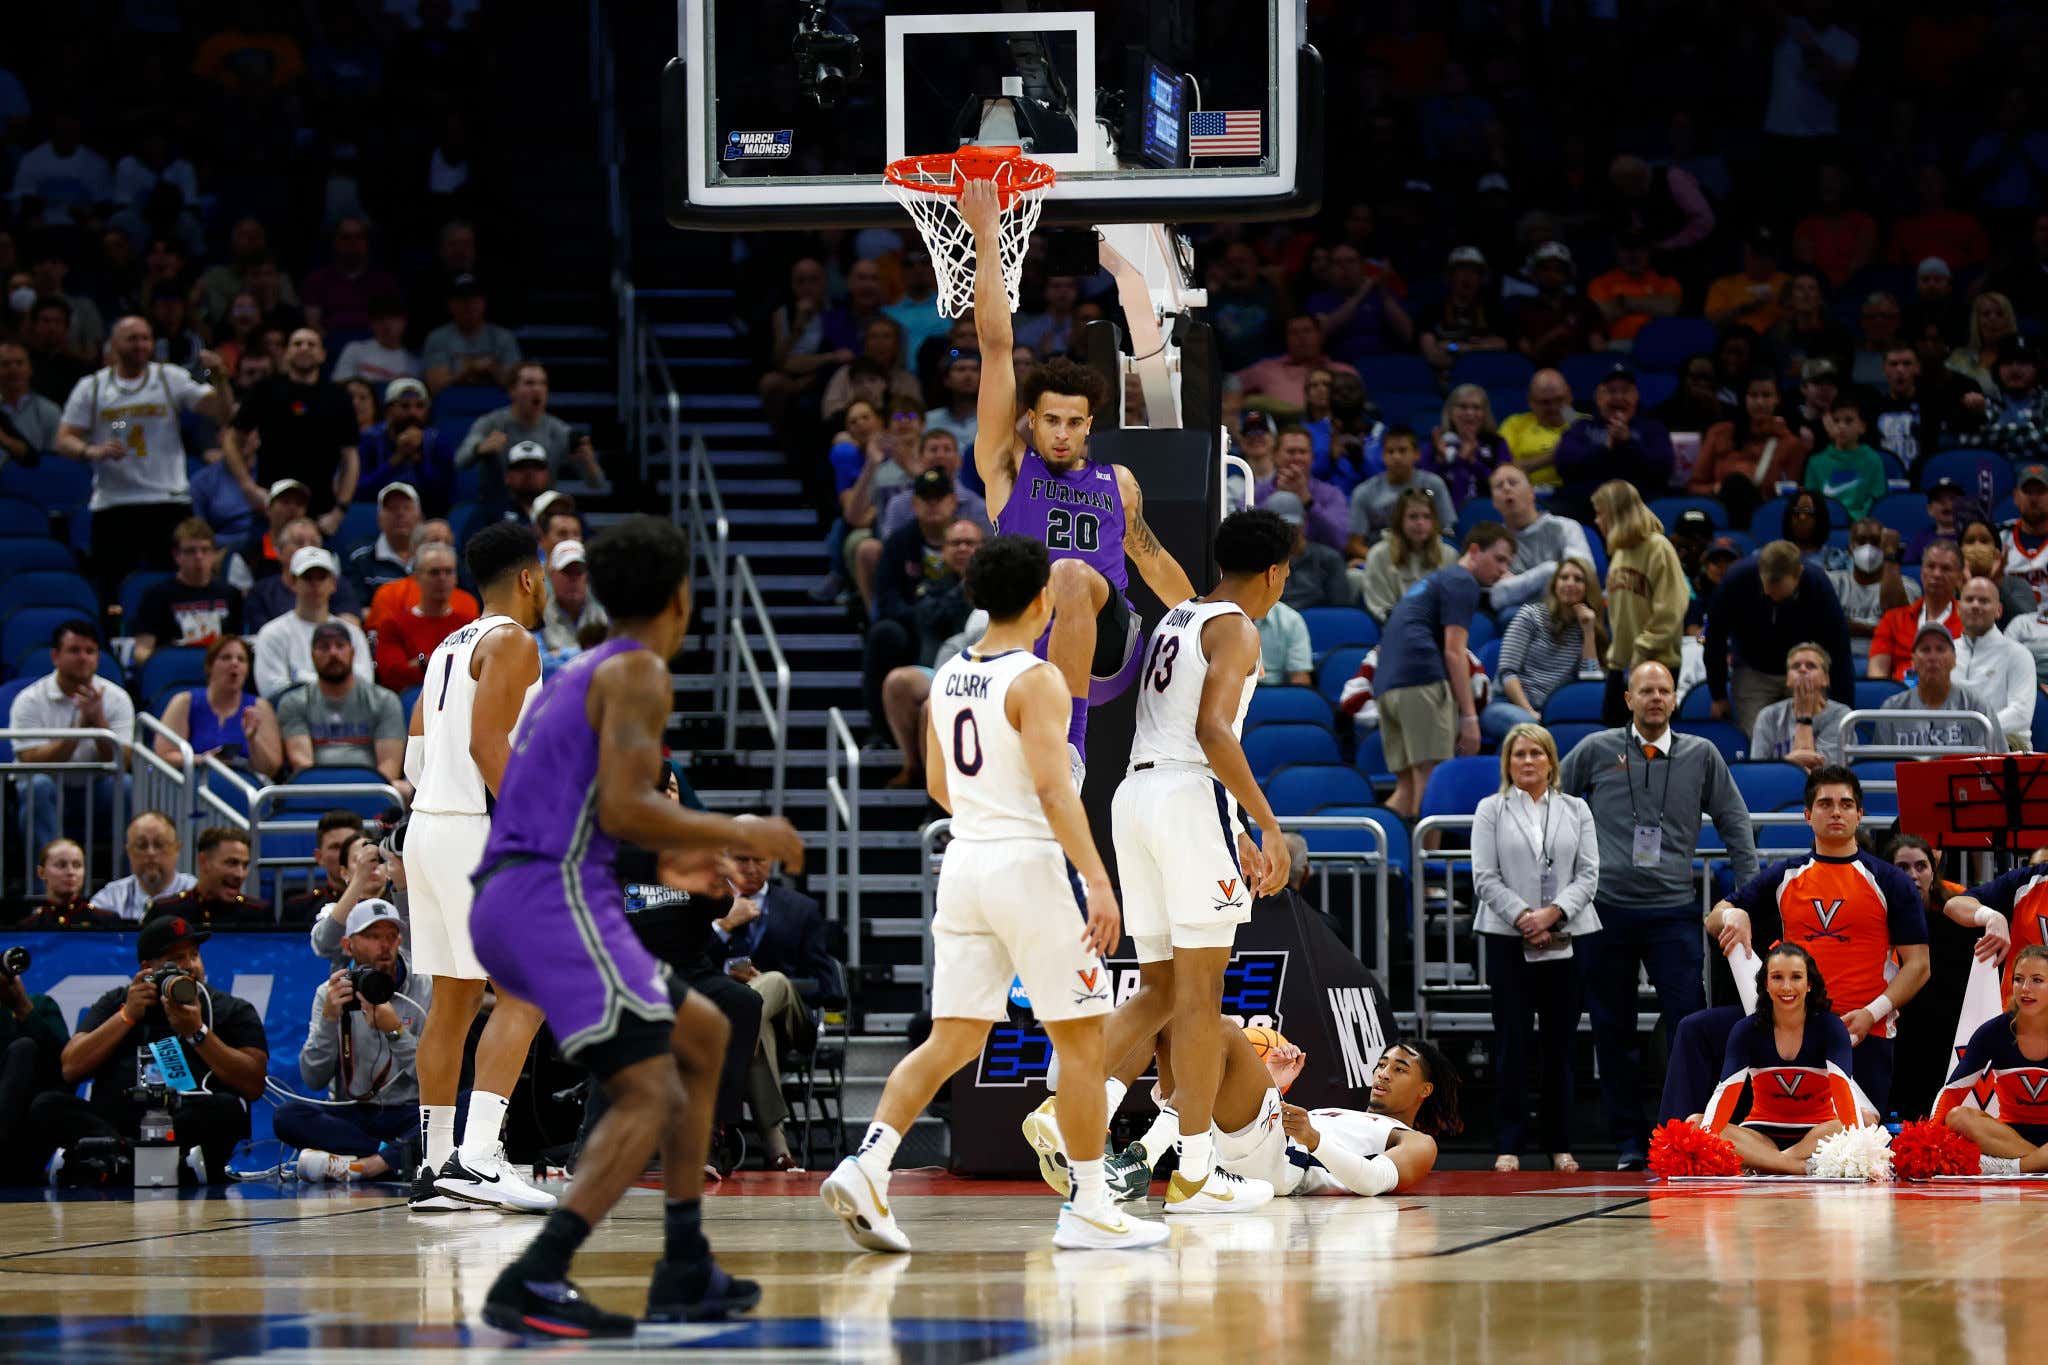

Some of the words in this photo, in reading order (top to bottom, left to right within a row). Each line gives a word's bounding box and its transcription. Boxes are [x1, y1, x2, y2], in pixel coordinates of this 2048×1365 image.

[740, 133, 775, 144] MARCH
[743, 143, 790, 154] MADNESS
[1030, 478, 1114, 513] FURMAN
[1045, 507, 1100, 553] 20
[1165, 608, 1196, 629] DUNN
[1143, 633, 1181, 694] 13
[438, 653, 455, 712] 1
[945, 673, 993, 699] CLARK
[953, 706, 984, 777] 0
